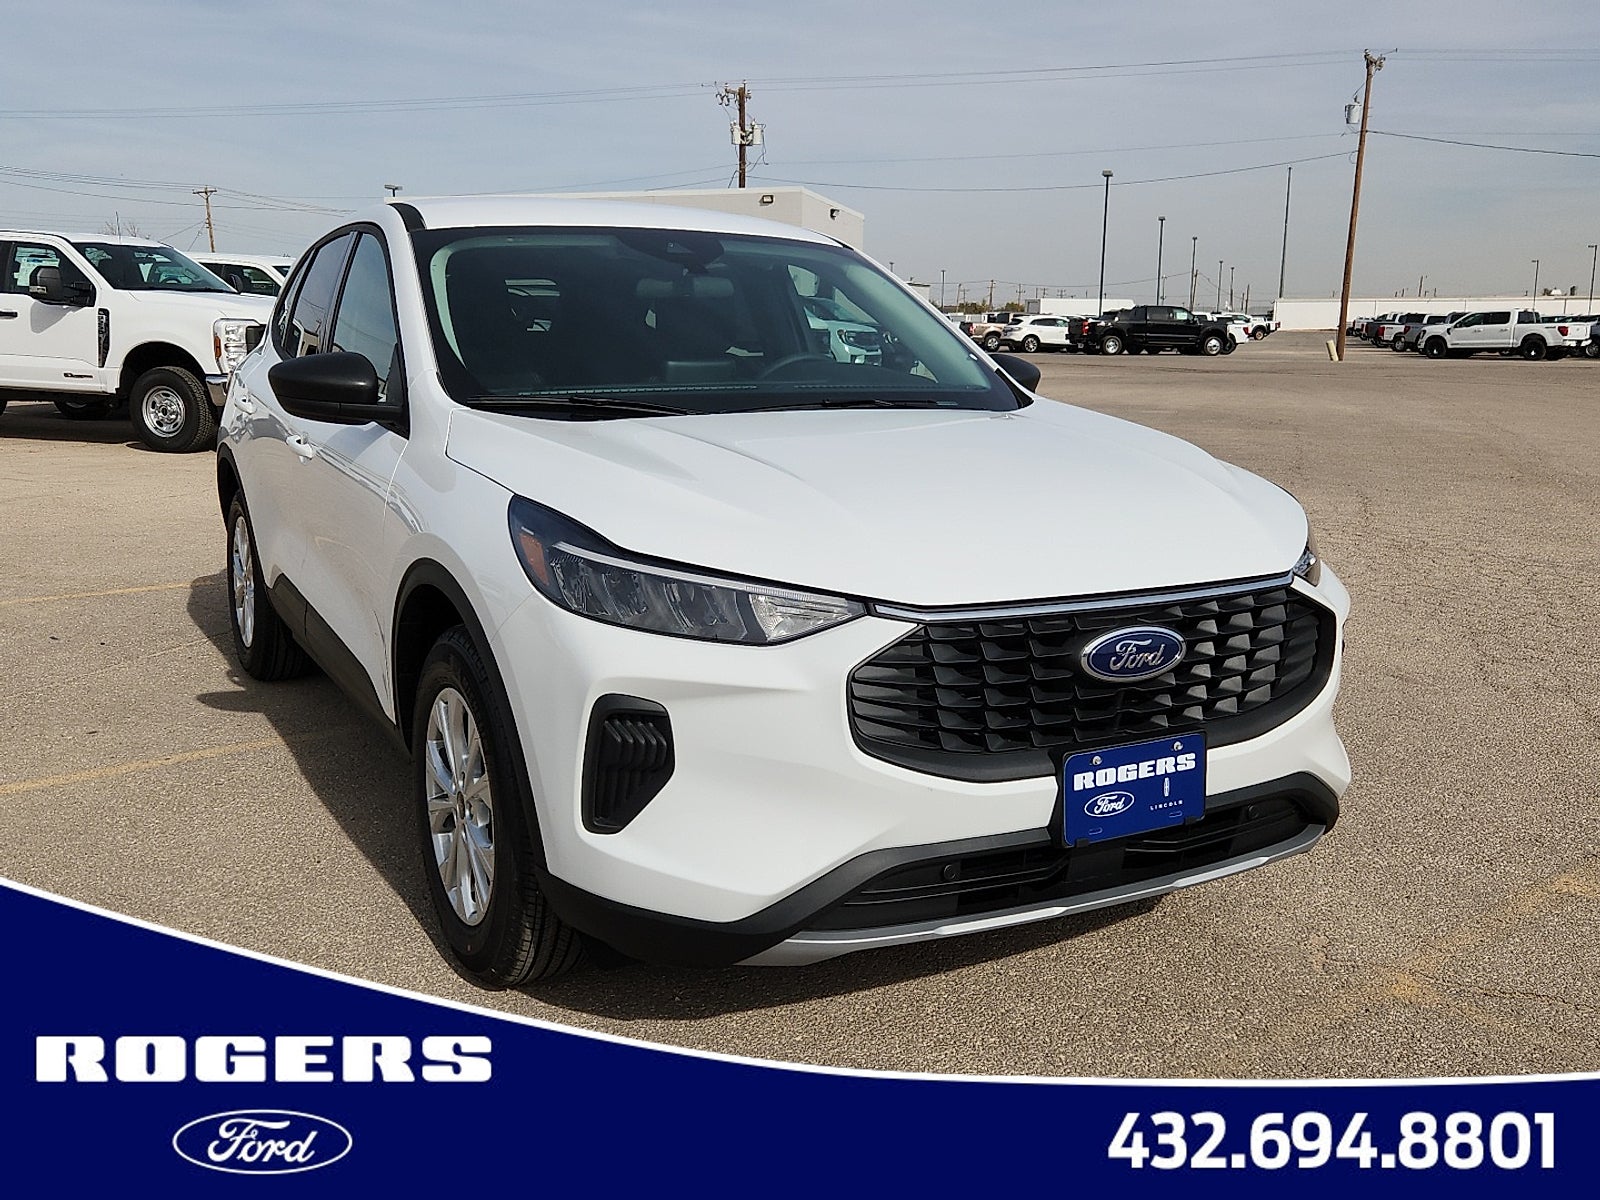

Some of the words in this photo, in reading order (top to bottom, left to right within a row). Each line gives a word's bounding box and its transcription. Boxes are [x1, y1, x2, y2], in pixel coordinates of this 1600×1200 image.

[1109, 638, 1165, 671] Ford
[1073, 753, 1196, 791] ROGERS
[1093, 794, 1125, 814] Ford
[1150, 800, 1183, 811] LINCOLN
